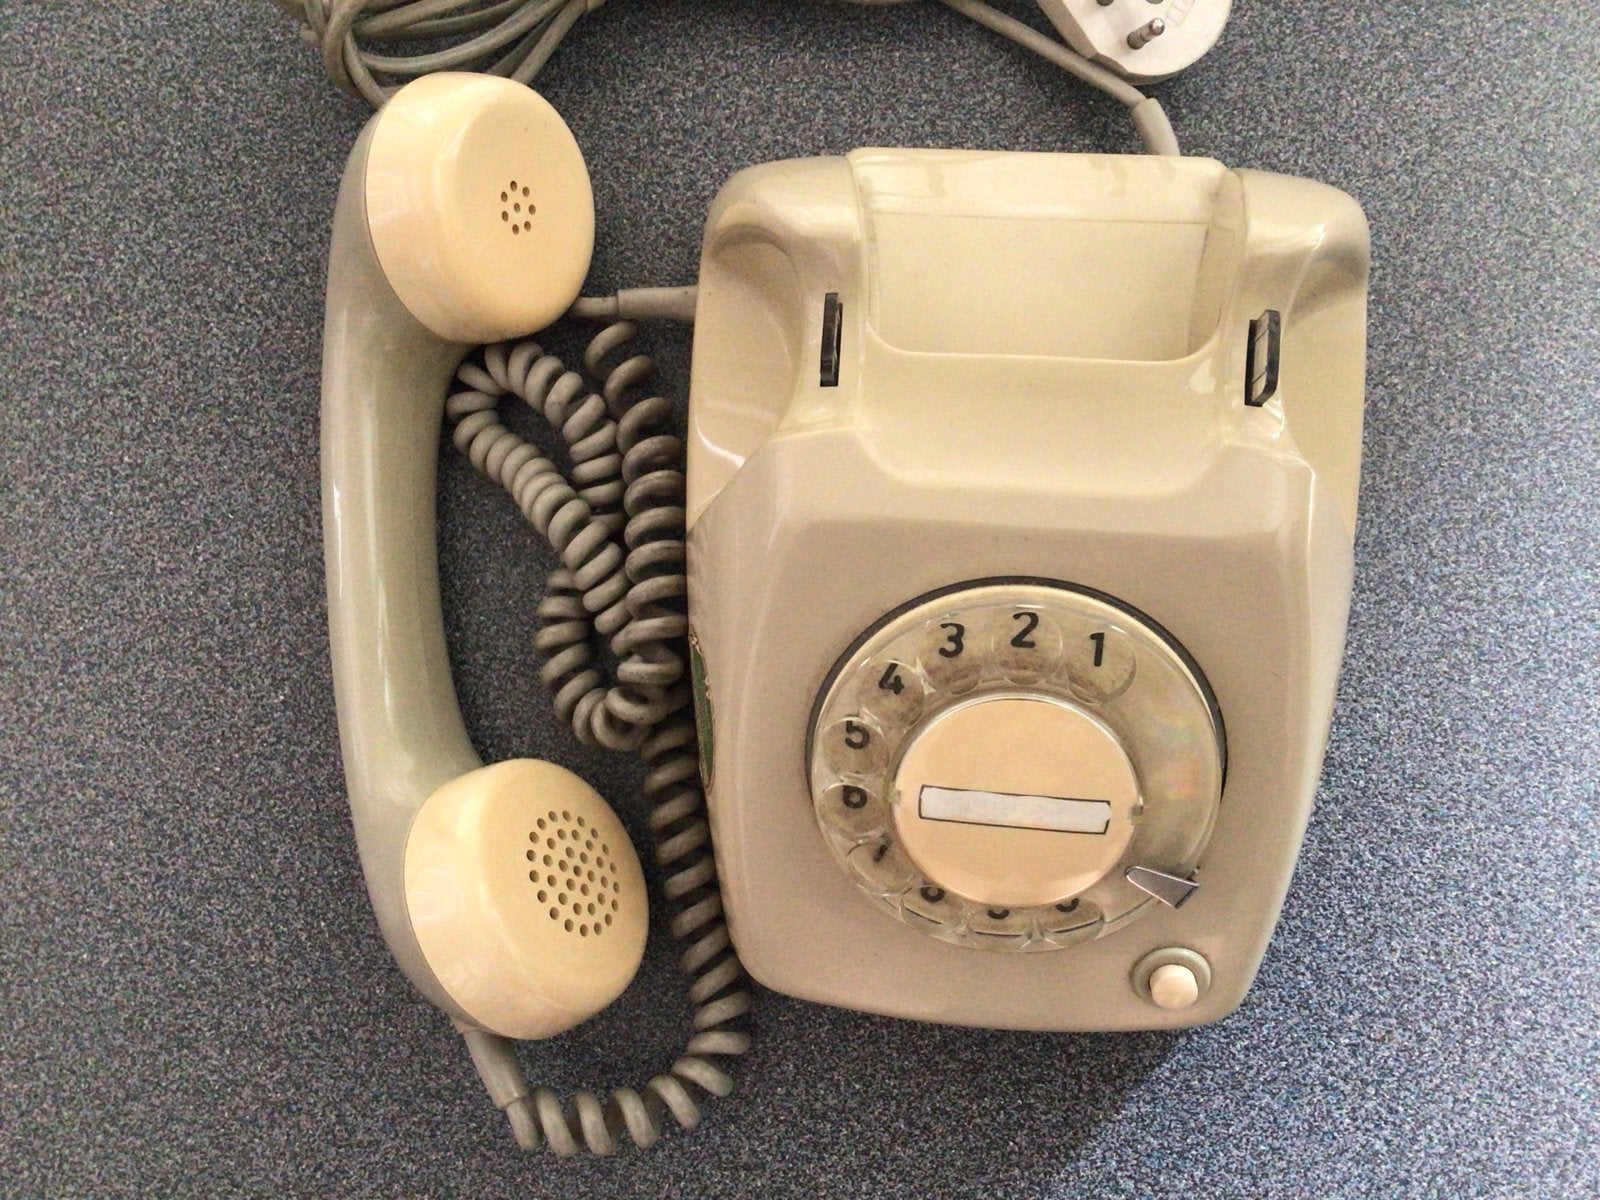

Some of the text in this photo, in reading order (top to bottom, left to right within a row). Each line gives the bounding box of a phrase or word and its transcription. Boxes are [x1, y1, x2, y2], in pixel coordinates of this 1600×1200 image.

[938, 622, 965, 658] 3
[1010, 611, 1040, 649] 2
[1089, 631, 1106, 668] 1
[878, 661, 905, 695] 4
[844, 713, 870, 750] 5
